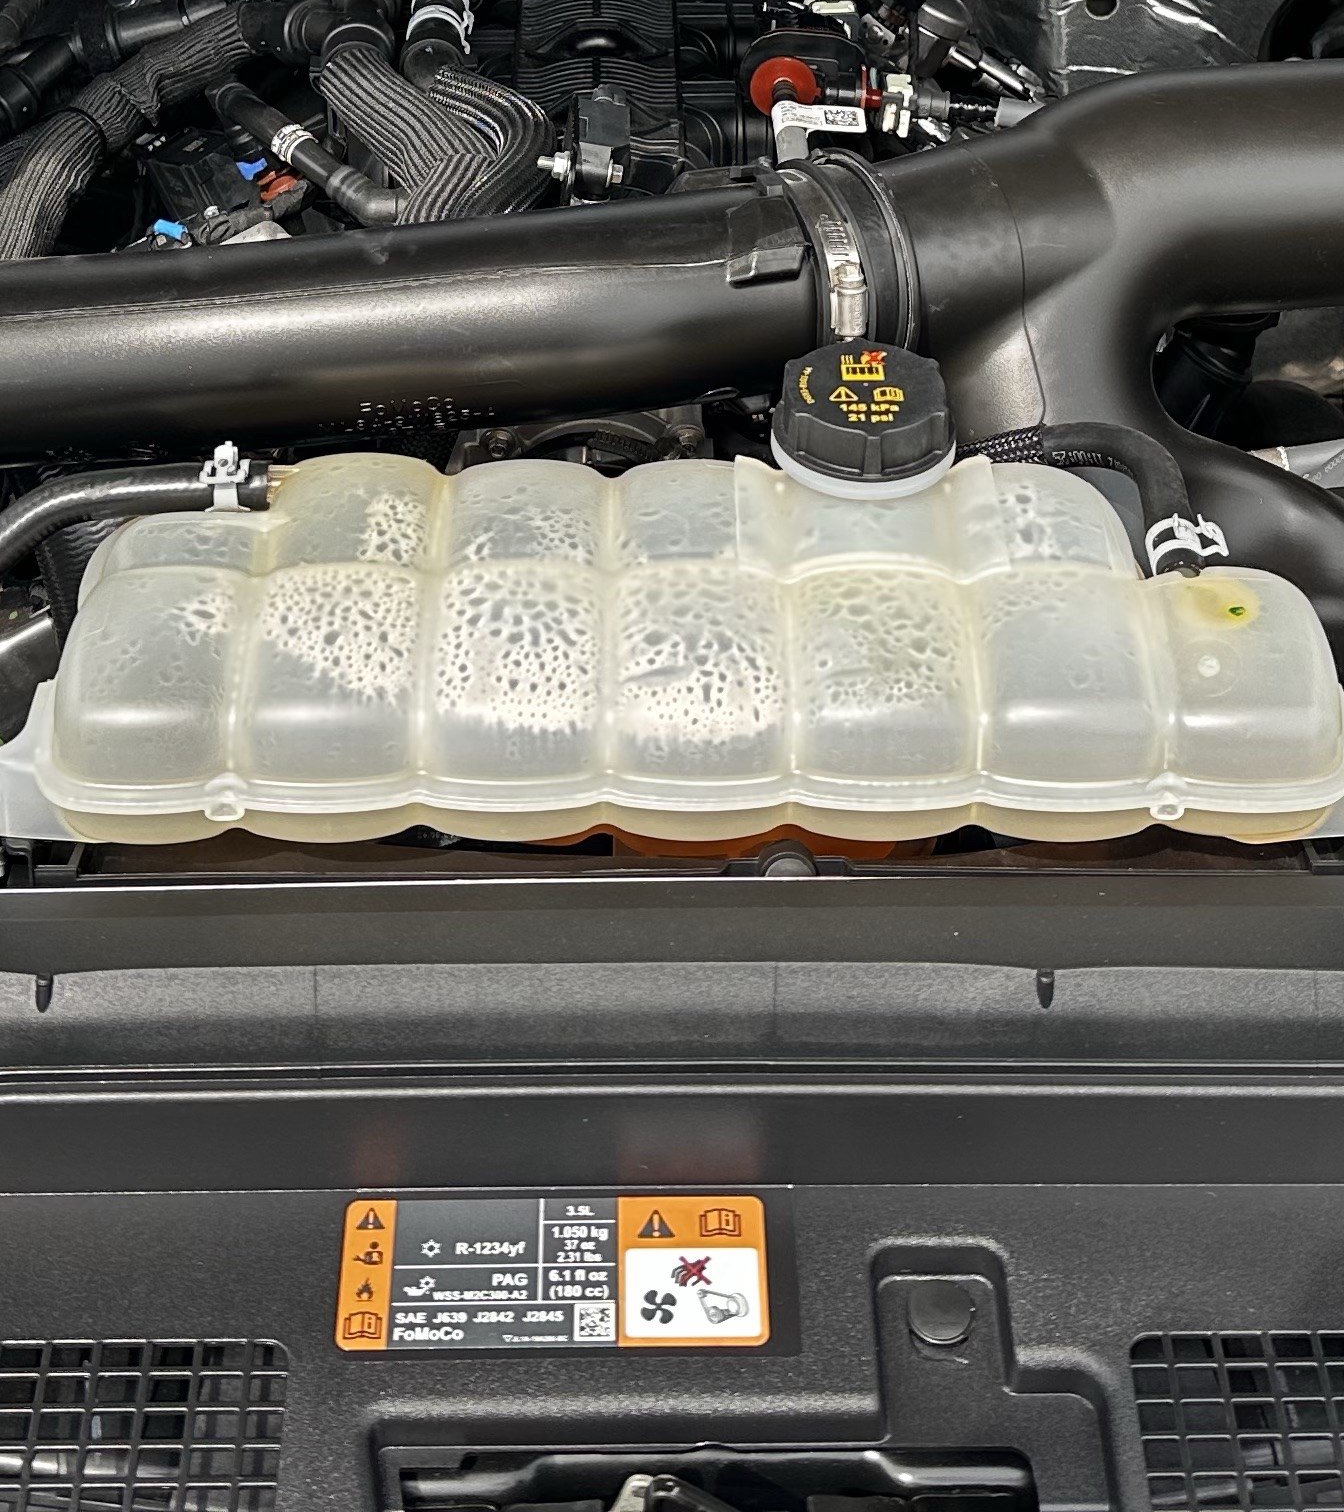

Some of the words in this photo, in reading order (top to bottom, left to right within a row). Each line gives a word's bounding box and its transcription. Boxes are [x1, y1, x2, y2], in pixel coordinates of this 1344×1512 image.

[839, 403, 868, 412] 145
[870, 403, 900, 412] kPa
[847, 414, 866, 422] 21
[870, 414, 894, 423] psi
[566, 1205, 595, 1216] 3.5L
[552, 1226, 588, 1238] 1.050
[590, 1226, 609, 1241] kg
[455, 1241, 527, 1257] R-1234yf
[564, 1241, 577, 1250] 37
[580, 1241, 596, 1250] oz
[556, 1252, 581, 1262] 2.31
[584, 1252, 602, 1262] lbs
[492, 1273, 529, 1286] PAG
[548, 1270, 571, 1281] 6.1
[574, 1269, 586, 1281] fl
[588, 1270, 609, 1281] oz
[549, 1285, 581, 1298] (180
[584, 1285, 610, 1299] cc)
[394, 1311, 427, 1324] SAE
[432, 1311, 468, 1324] J639
[472, 1311, 515, 1323] J2842
[522, 1310, 565, 1323] J2845
[393, 1327, 465, 1341] FoMoCo
